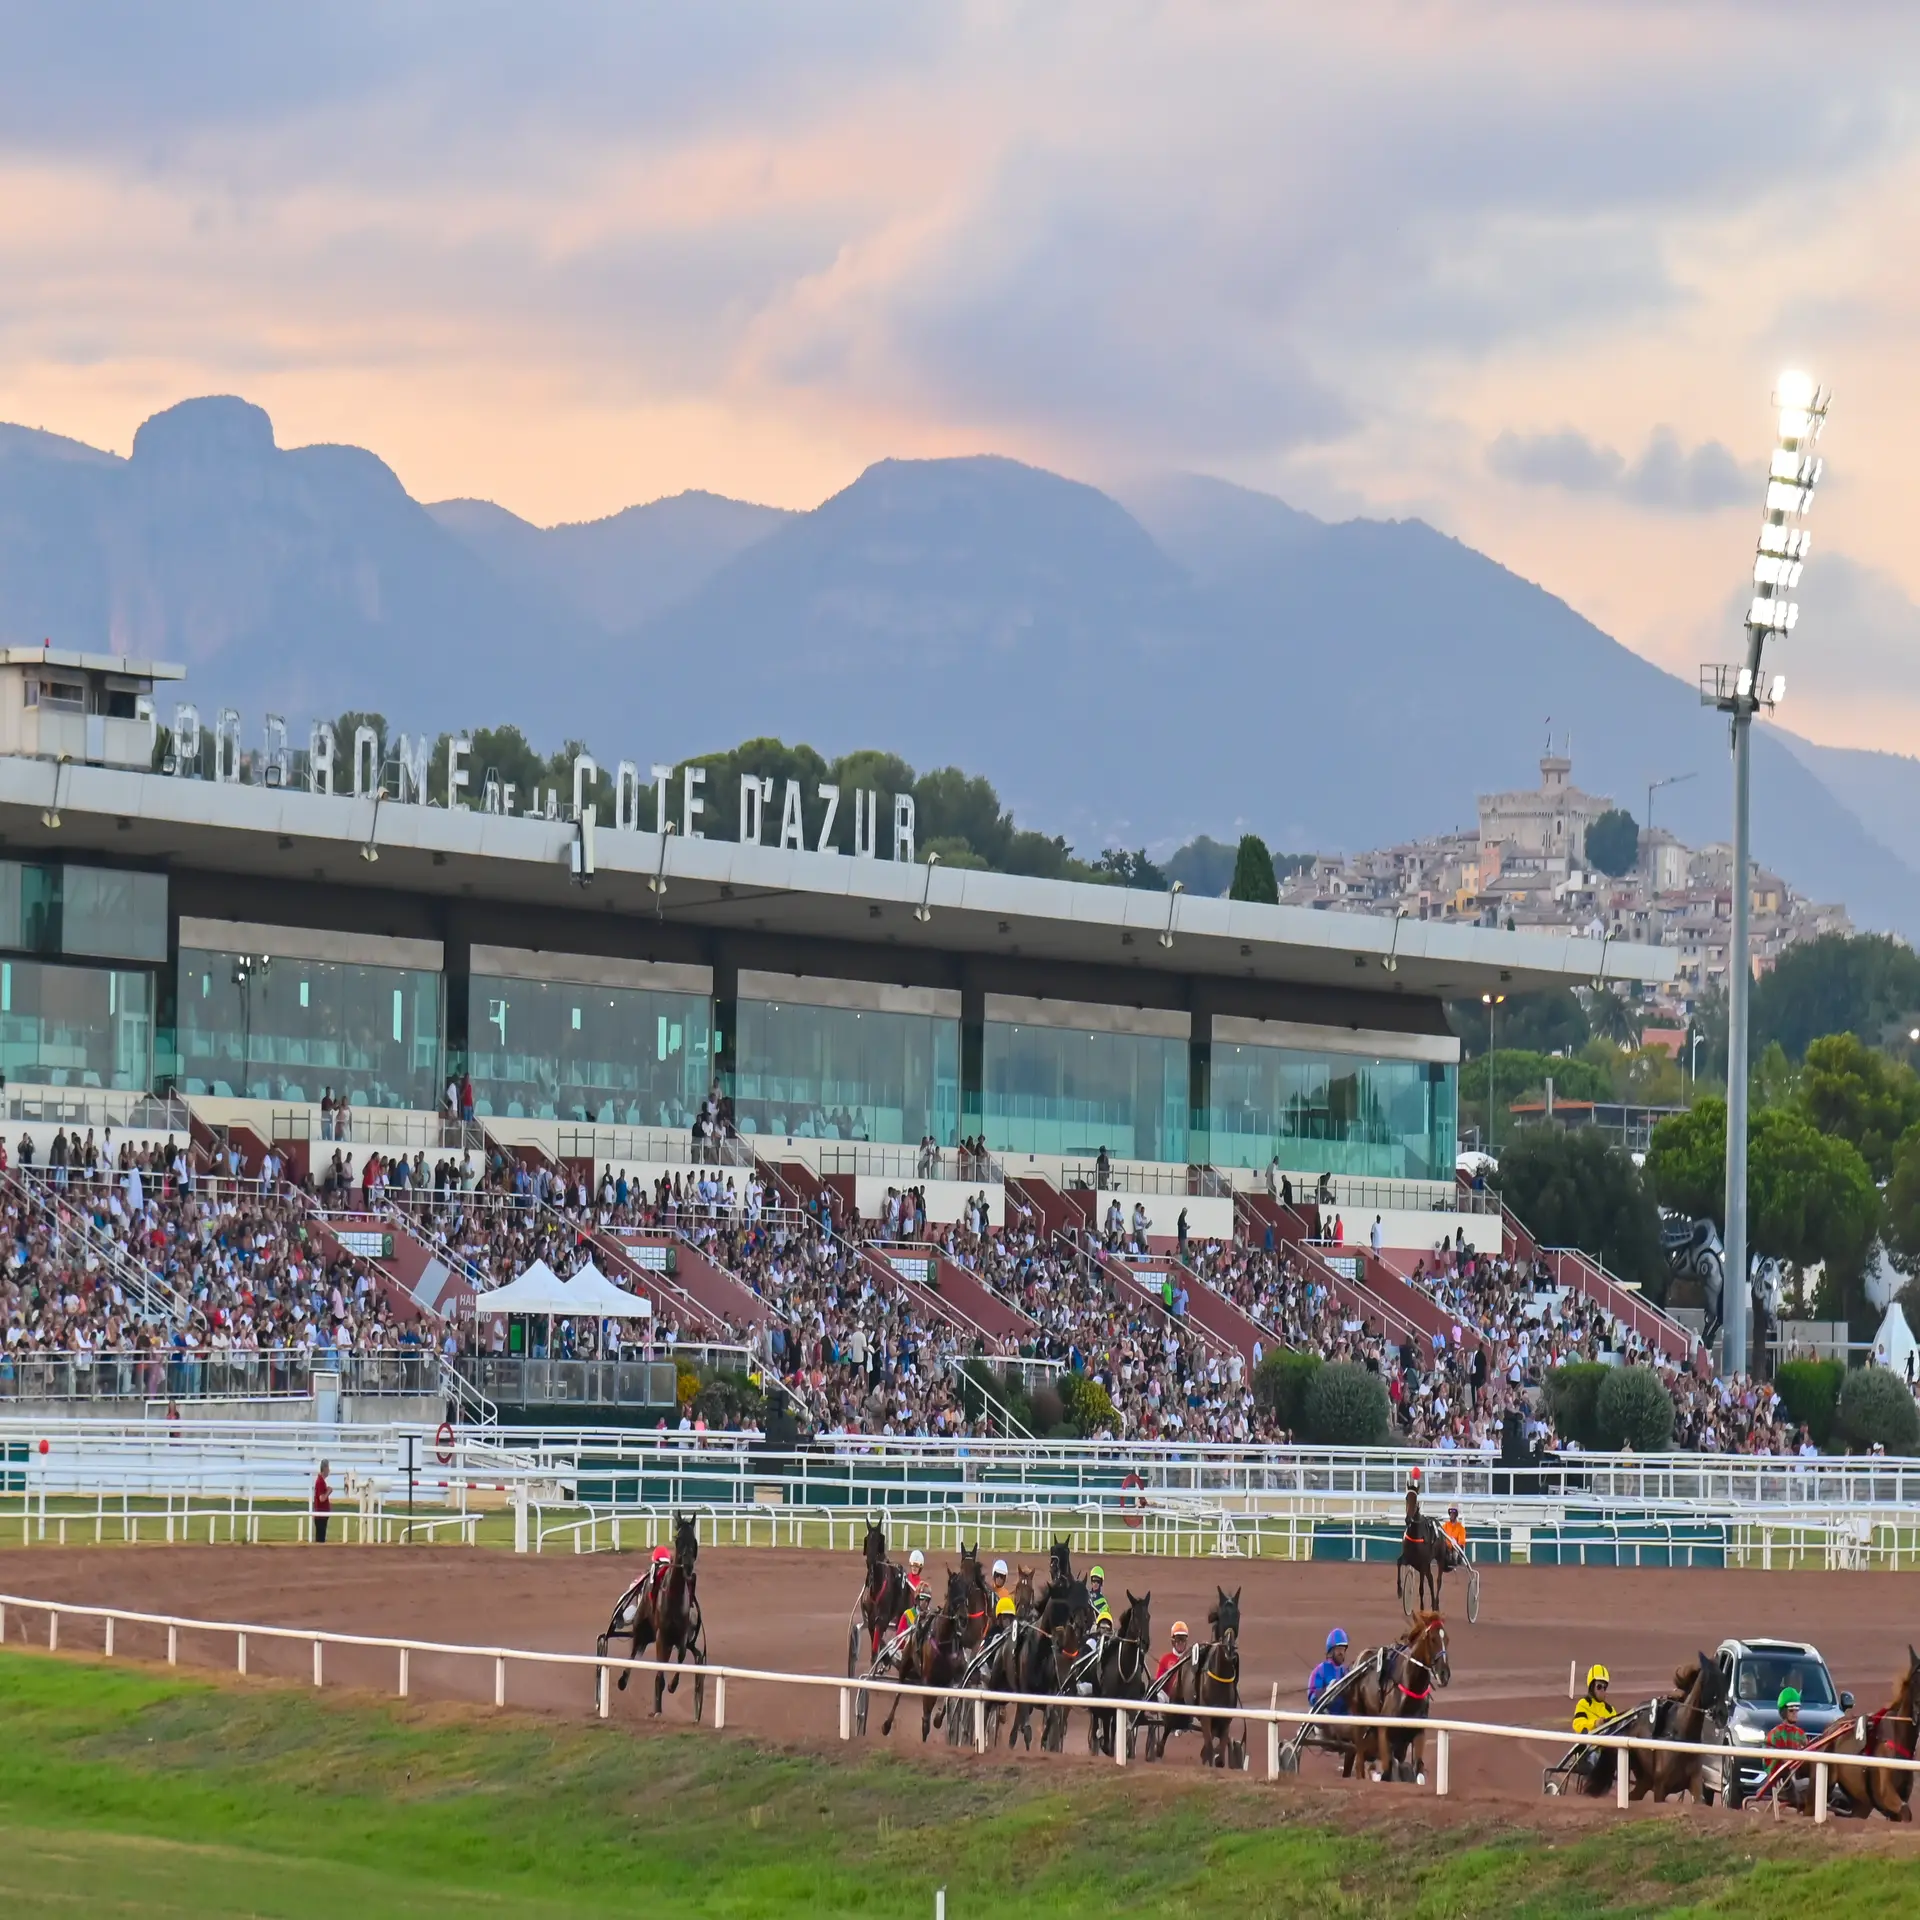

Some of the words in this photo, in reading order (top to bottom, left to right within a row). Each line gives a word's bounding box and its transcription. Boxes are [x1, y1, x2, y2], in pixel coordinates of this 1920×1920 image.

[740, 773, 916, 864] D'AZUR
[1011, 1619, 1018, 1642] 8
[1649, 1697, 1658, 1724] 3
[1855, 1715, 1865, 1741] 4
